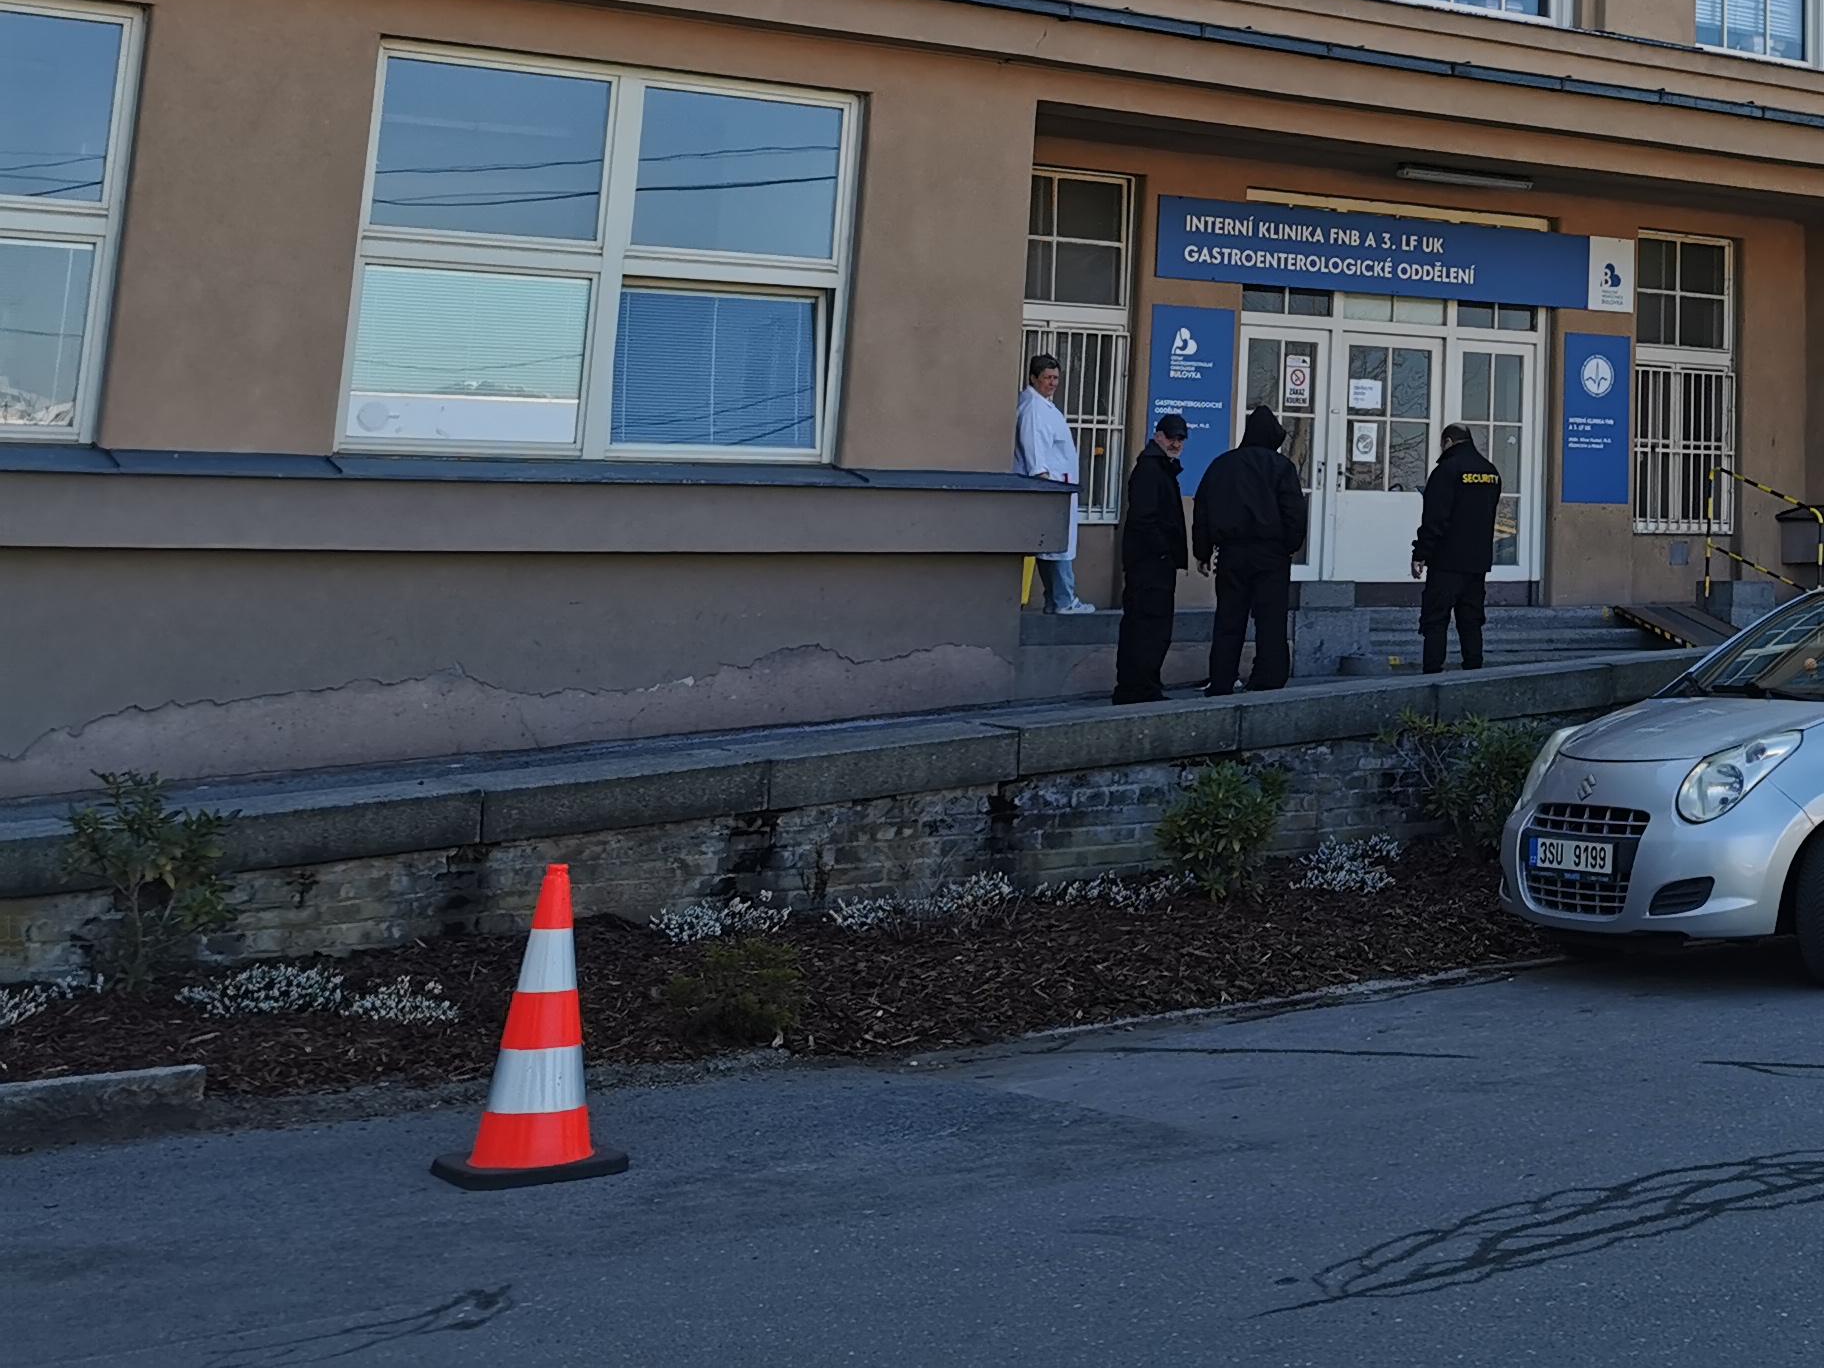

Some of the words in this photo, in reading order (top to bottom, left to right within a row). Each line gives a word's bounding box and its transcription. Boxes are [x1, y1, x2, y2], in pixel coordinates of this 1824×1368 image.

[1185, 214, 1254, 237] INTERNÍ
[1258, 221, 1324, 243] KLINIKA
[1329, 228, 1360, 246] FNB
[1364, 232, 1376, 248] A
[1381, 233, 1396, 250] 3.
[1401, 234, 1418, 251] LF
[1422, 237, 1444, 253] UK
[1184, 244, 1393, 278] GASTROENTEROLOGICKÉ
[1397, 261, 1475, 284] ODDĚLENÍ
[1169, 371, 1201, 379] BULOVKA
[1462, 473, 1499, 484] SECURITY
[1540, 841, 1564, 866] 3SU
[1573, 844, 1606, 870] 9199
